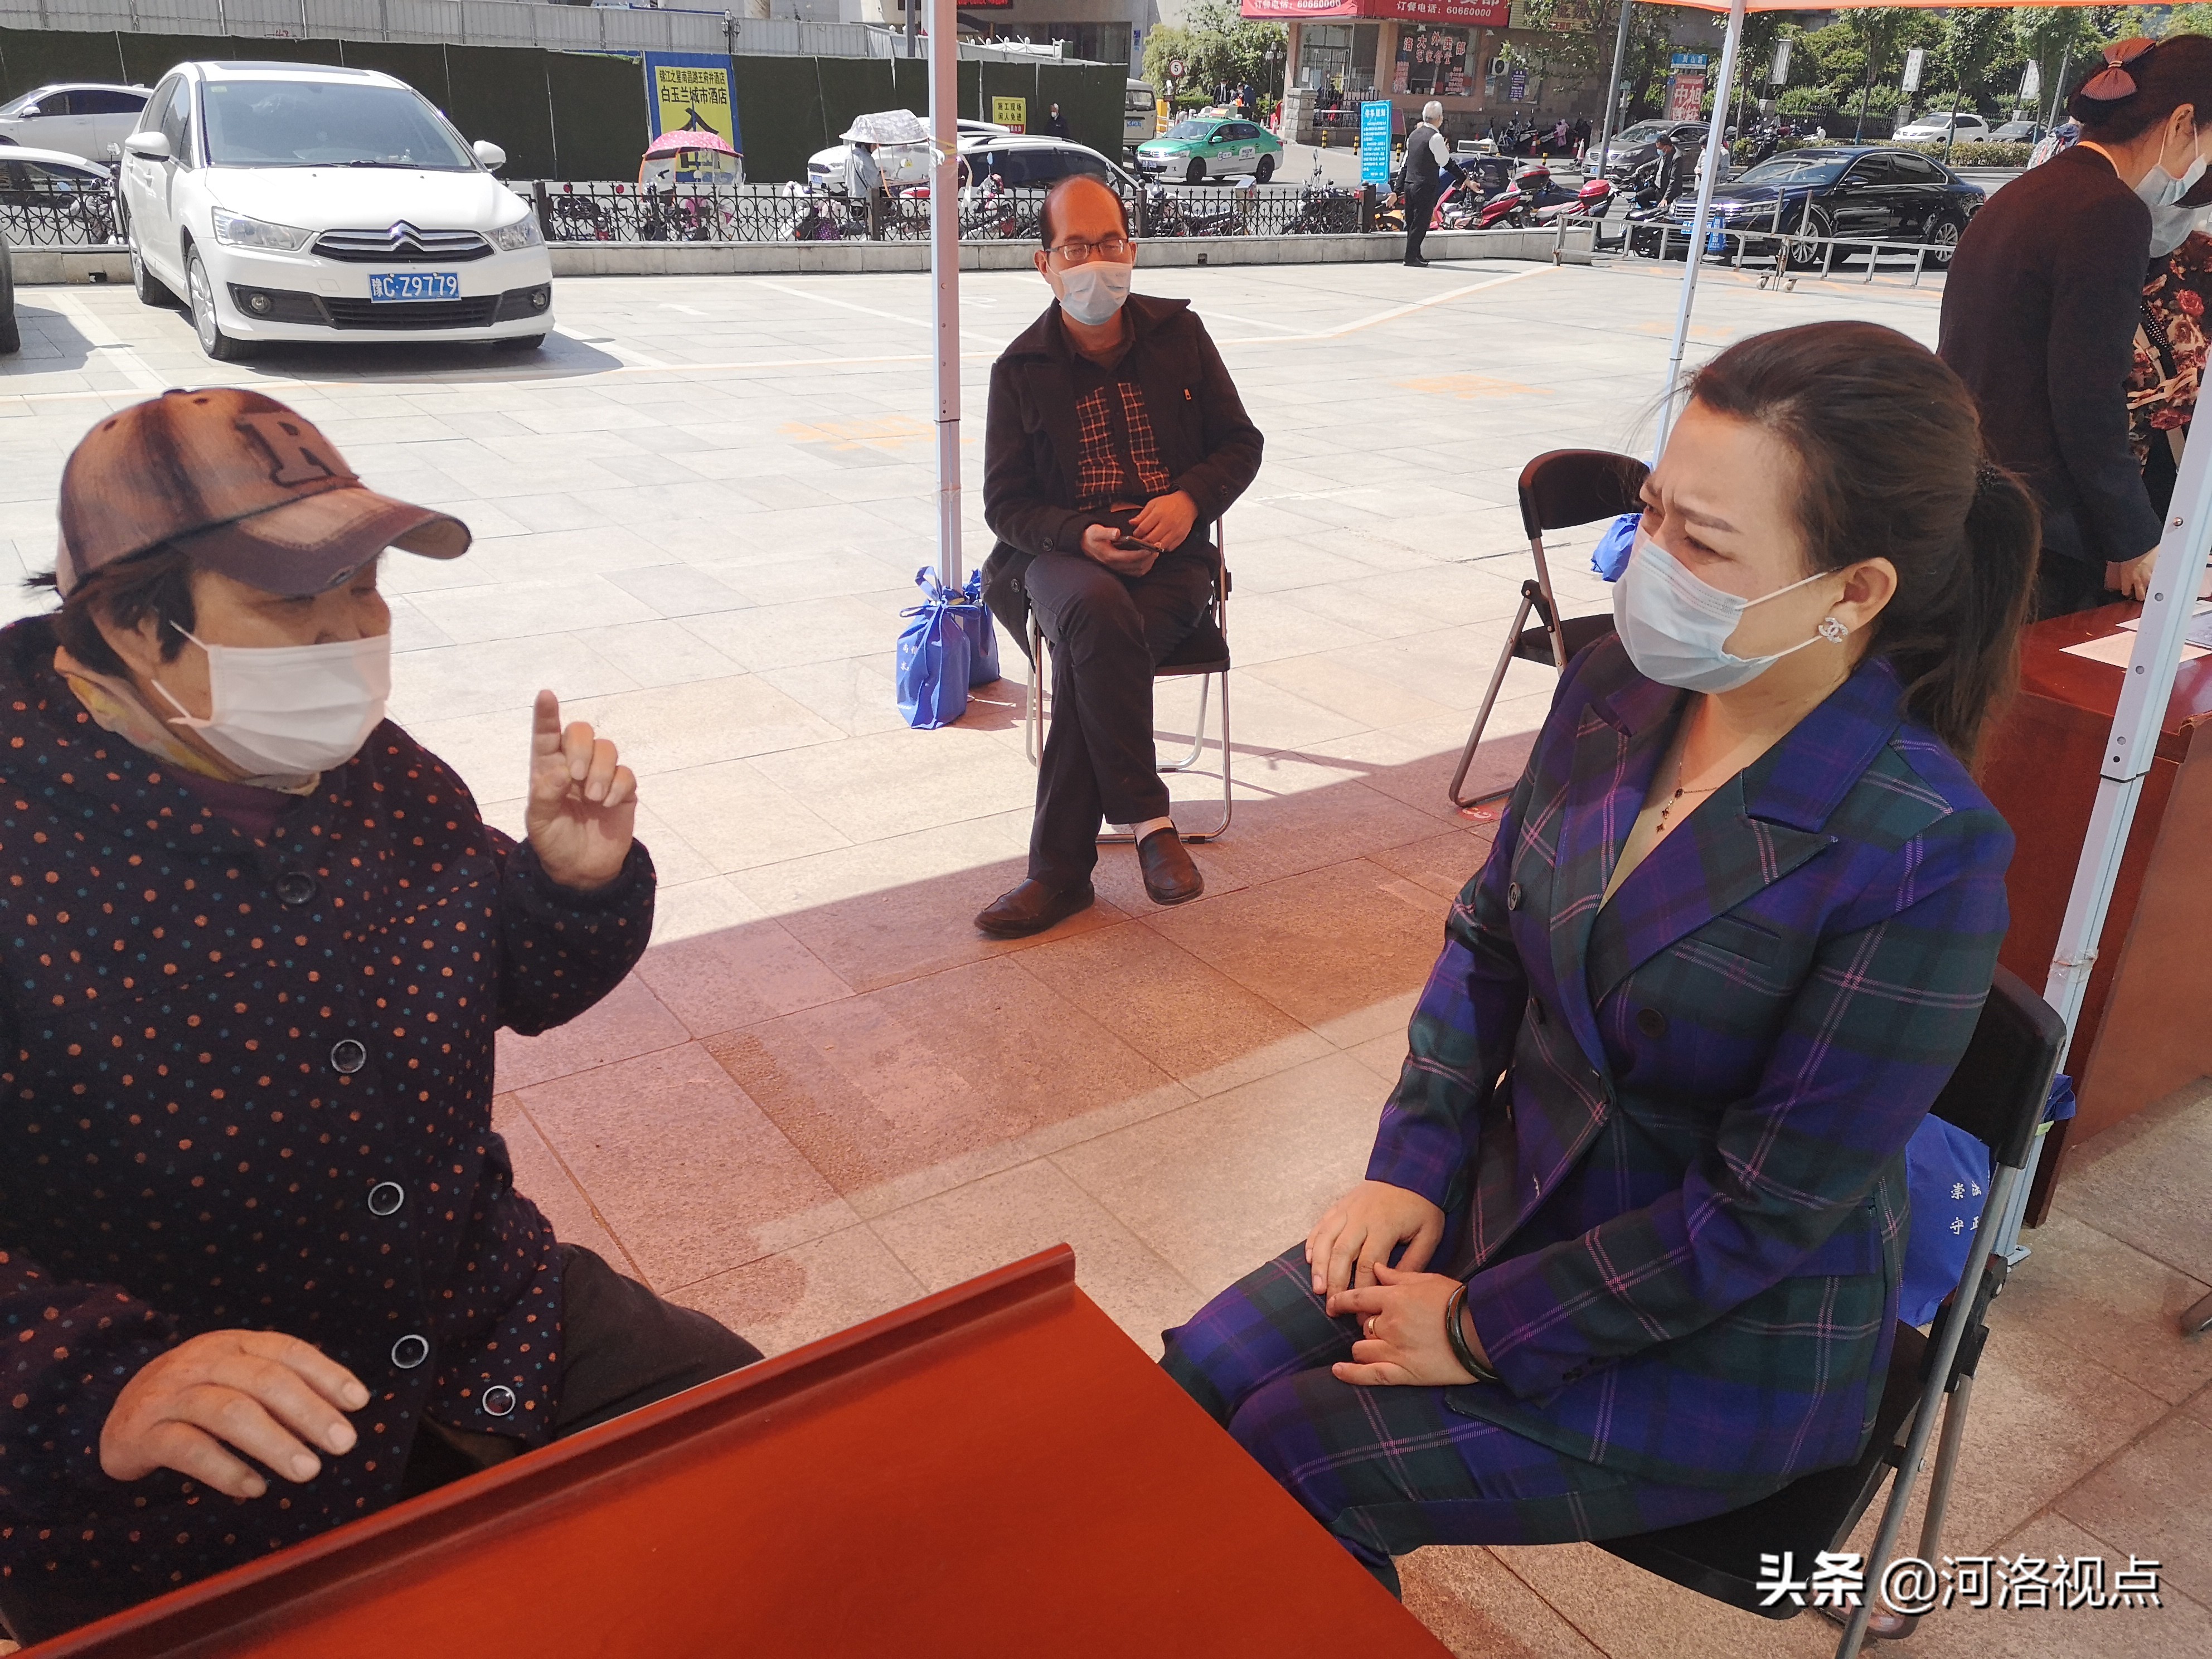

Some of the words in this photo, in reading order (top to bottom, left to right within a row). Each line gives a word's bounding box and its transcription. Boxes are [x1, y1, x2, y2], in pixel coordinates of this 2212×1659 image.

[661, 85, 727, 105] 白玉兰城市酒店
[998, 102, 1022, 111] 施工现场
[998, 112, 1022, 122] 闲人免进
